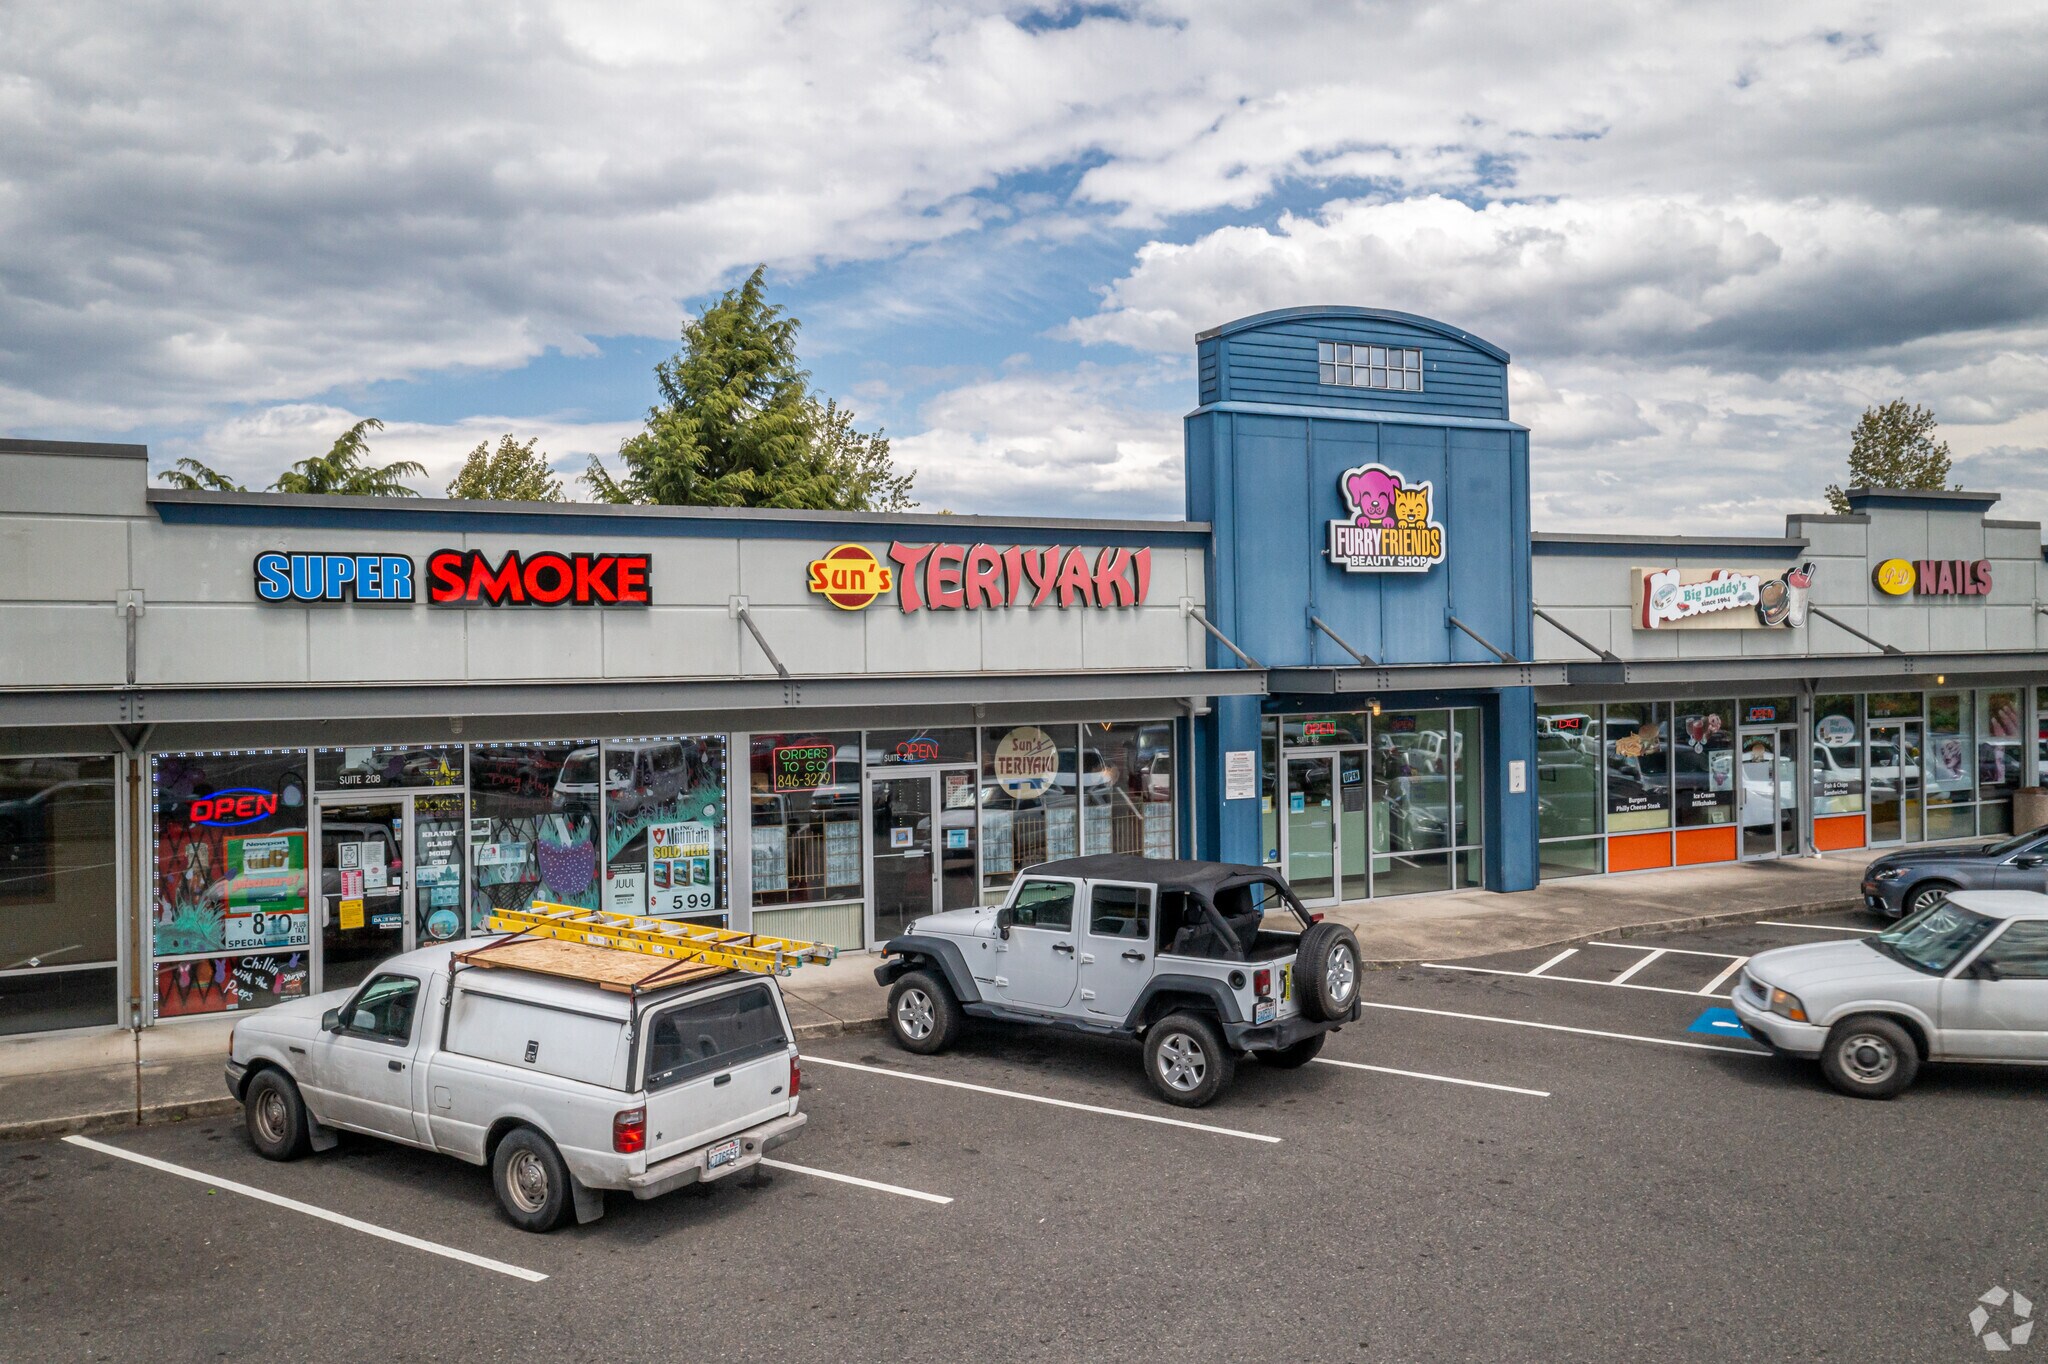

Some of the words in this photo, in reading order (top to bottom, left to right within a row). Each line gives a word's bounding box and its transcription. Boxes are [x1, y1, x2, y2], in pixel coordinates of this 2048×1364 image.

[1351, 556, 1394, 566] BEAUTY
[1397, 556, 1427, 567] SHOP
[256, 552, 413, 601] SUPER
[430, 552, 649, 603] SMOKE
[812, 562, 891, 591] Sun's
[887, 541, 1151, 614] TERIYAKI
[1919, 560, 1993, 595] NAILS
[1683, 589, 1702, 602] Big
[1705, 580, 1747, 599] Daddy's
[1304, 721, 1335, 735] OPEN
[897, 742, 939, 759] OPEN
[1012, 737, 1042, 752] Sun's
[779, 748, 828, 761] ORDERS
[884, 754, 901, 762] SUITE
[903, 753, 914, 761] 210
[783, 761, 800, 772] TO
[805, 761, 827, 772] GO
[998, 756, 1055, 775] TERIYAKI
[340, 775, 362, 785] SUITE
[365, 774, 381, 784] 208
[777, 772, 831, 788] 846-3229
[1344, 771, 1358, 782] OPEN
[190, 792, 278, 821] OPEN
[1628, 796, 1647, 804] Burgers
[1616, 804, 1630, 813] Philly
[1630, 803, 1647, 811] Cheese
[1647, 802, 1661, 810] Steak
[422, 830, 456, 838] KRATOM
[666, 827, 710, 844] Mountain
[245, 840, 287, 848] Newport
[426, 840, 453, 848] GLASS
[653, 845, 682, 859] SOLD
[683, 844, 710, 857] HERE
[615, 878, 635, 889] JUUL
[651, 896, 657, 906] $
[238, 920, 243, 929] $
[228, 938, 267, 948] SPECIAL
[241, 956, 279, 976] Chillin
[232, 968, 253, 984] with
[255, 976, 268, 990] the
[224, 979, 254, 1001] Peeps
